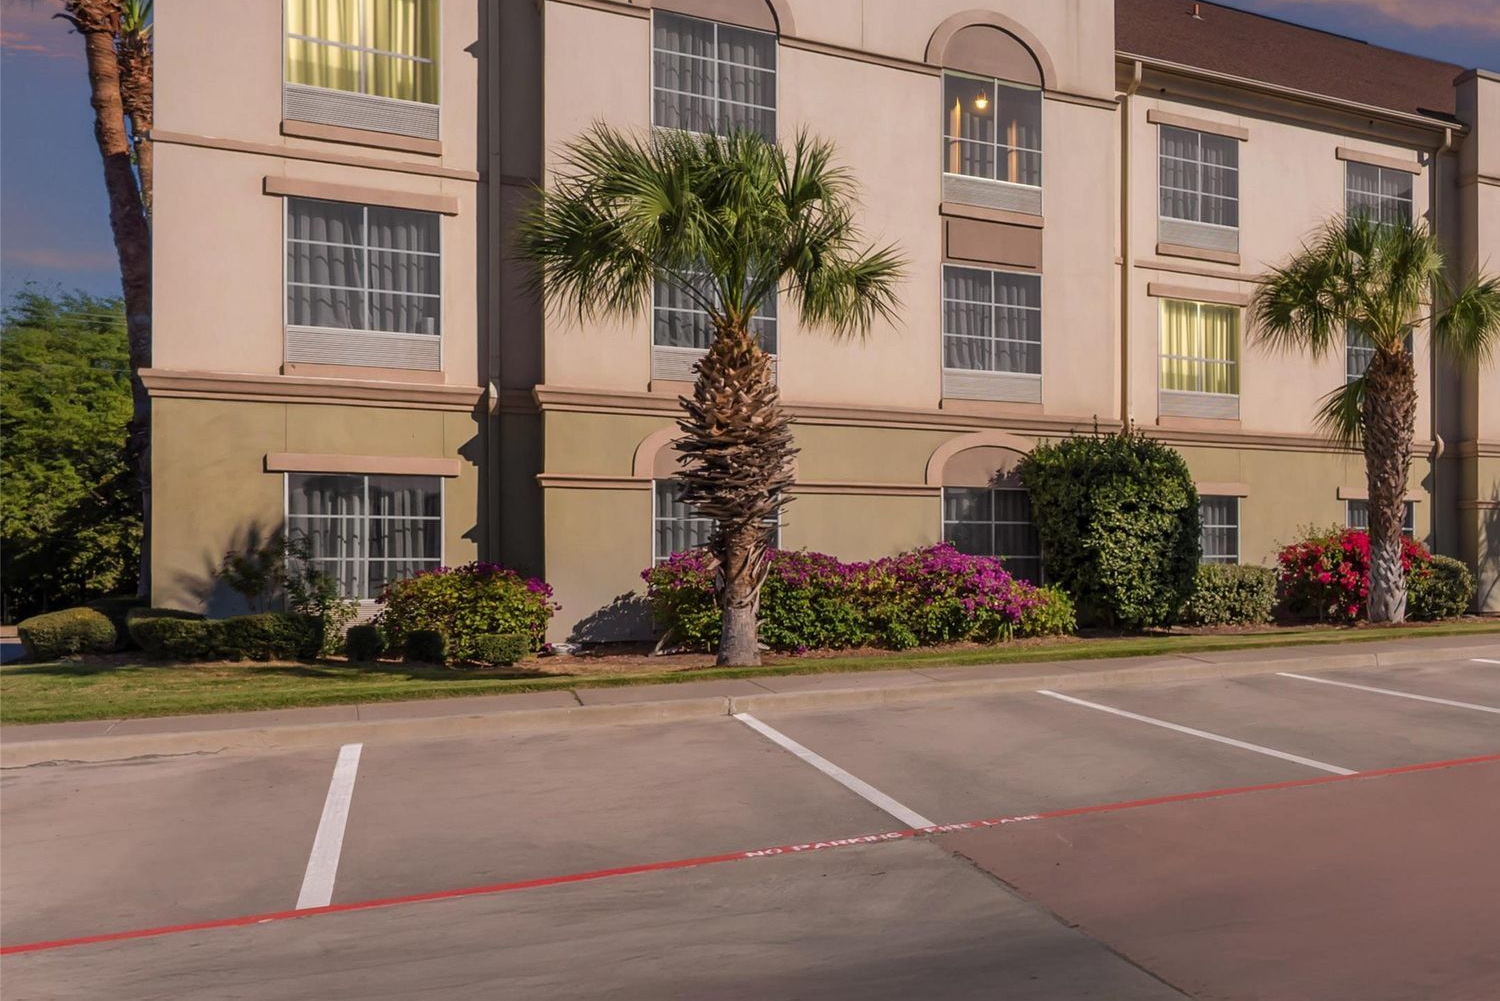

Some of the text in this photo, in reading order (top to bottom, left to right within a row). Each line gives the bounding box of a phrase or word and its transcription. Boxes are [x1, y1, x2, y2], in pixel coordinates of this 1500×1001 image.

[745, 814, 1040, 858] NO PARKING FIRE LANE
